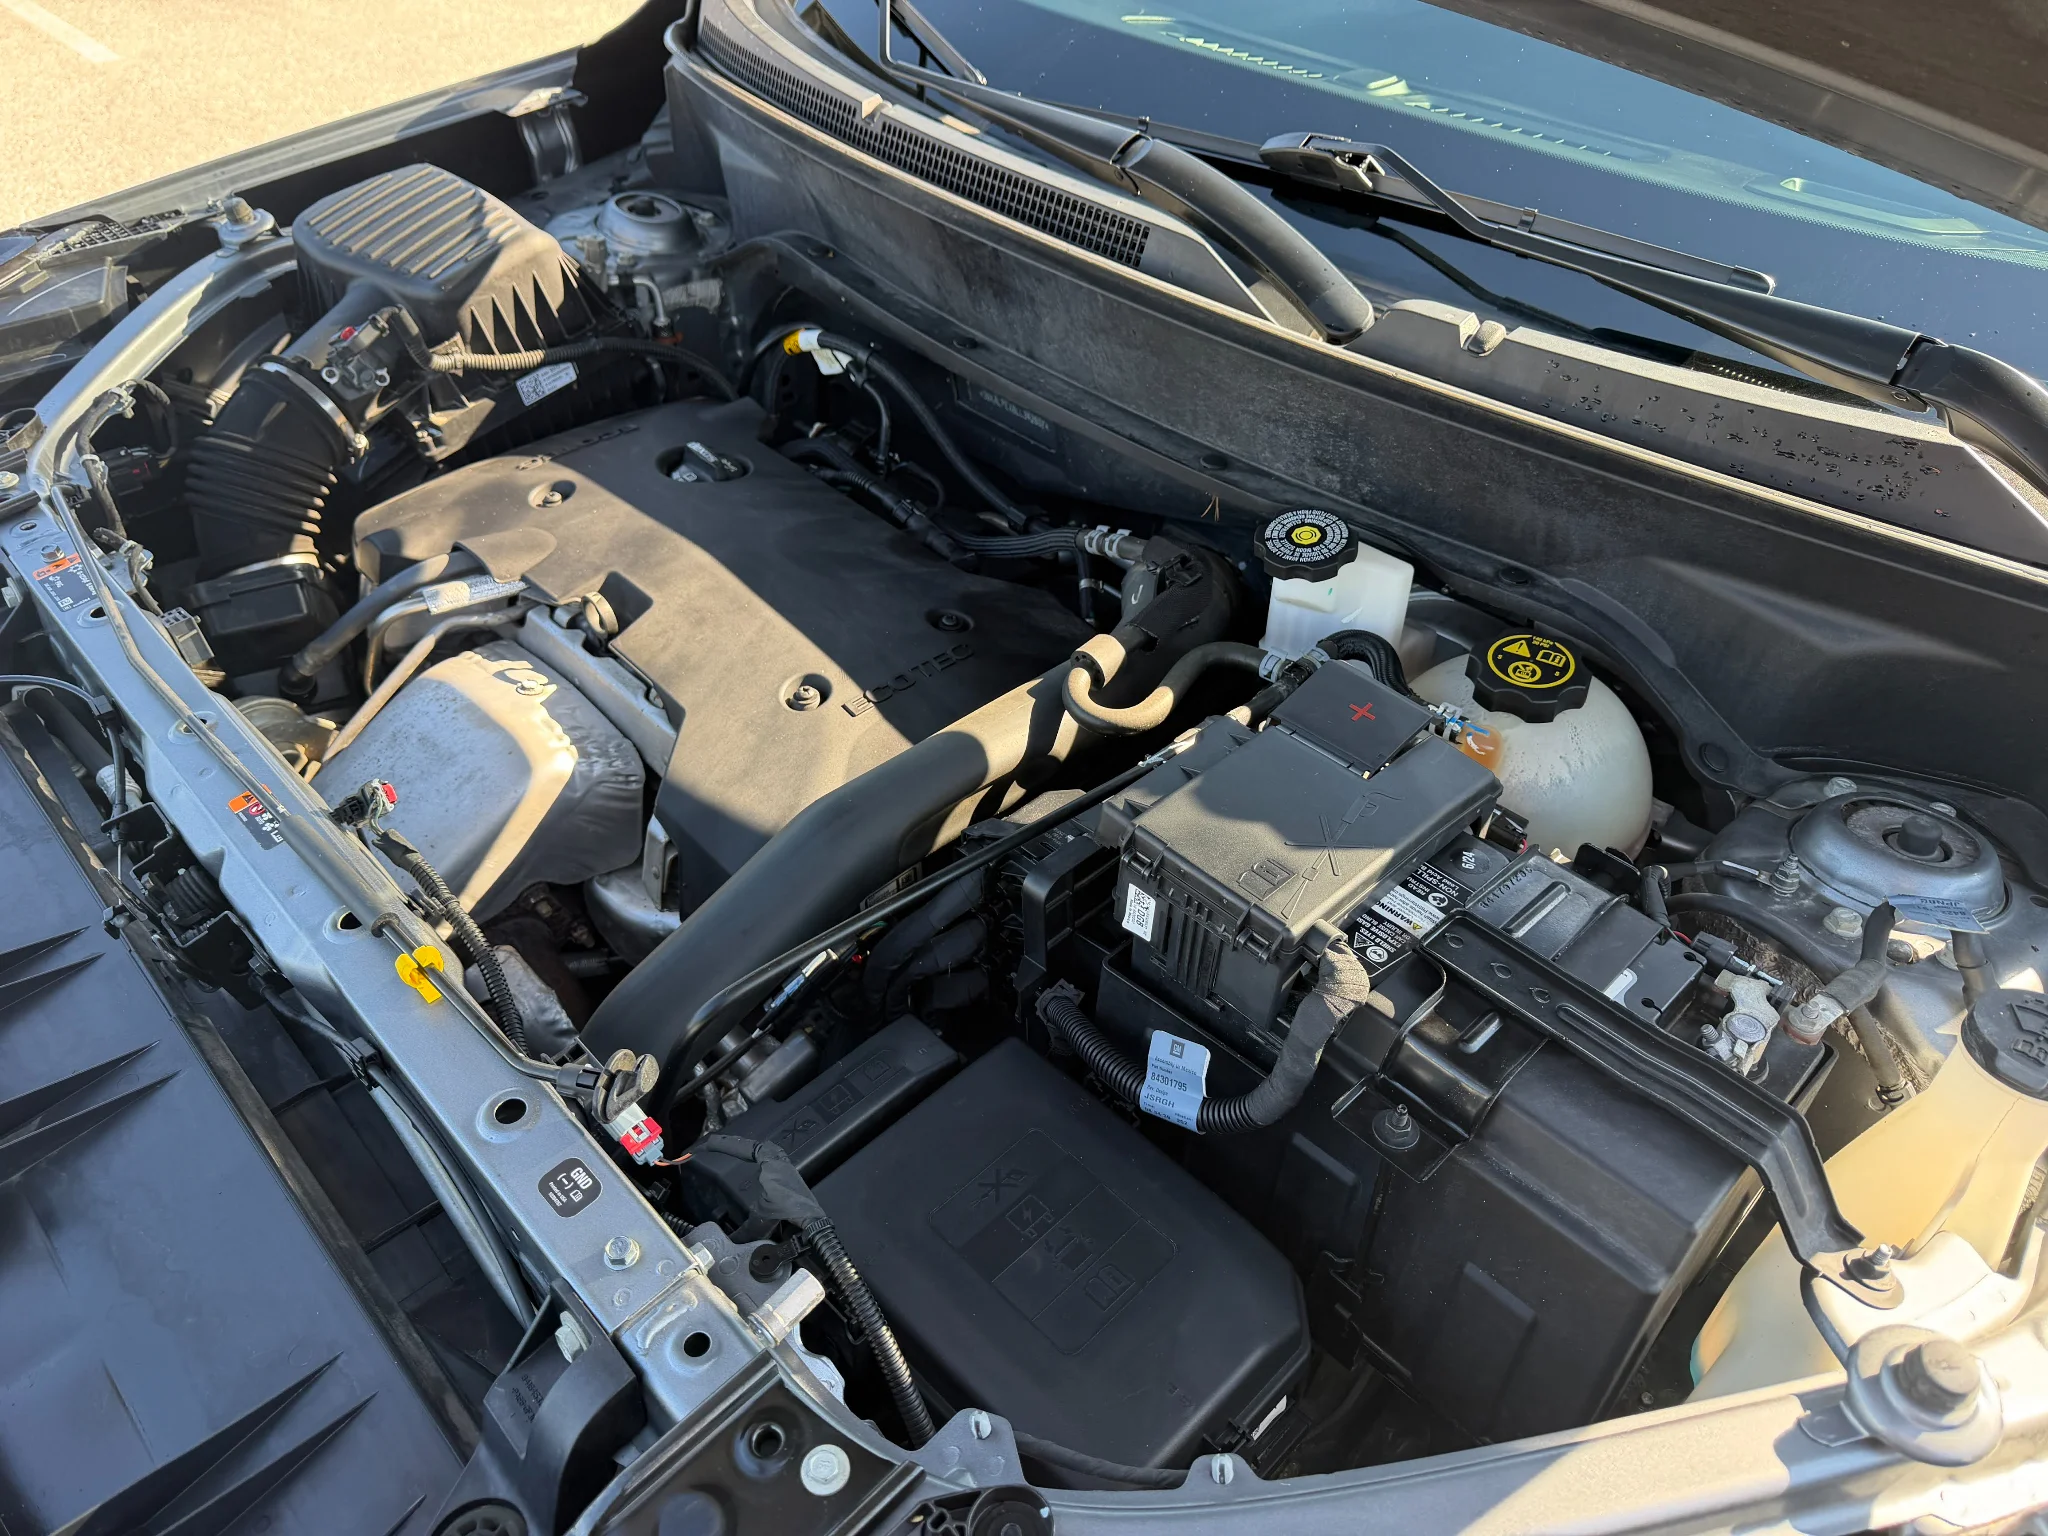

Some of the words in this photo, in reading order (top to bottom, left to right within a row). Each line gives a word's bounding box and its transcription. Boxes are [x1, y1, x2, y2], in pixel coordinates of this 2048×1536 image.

[842, 642, 975, 718] ECOTEC
[1462, 851, 1476, 869] 6/24
[1426, 868, 1442, 880] Acid
[1407, 882, 1426, 896] READ
[1442, 878, 1460, 891] Lead
[1370, 925, 1402, 948] EXPLOSIVE
[1377, 923, 1396, 937] CAUSE
[1402, 932, 1411, 940] OR
[1375, 937, 1397, 953] SHIELD
[1394, 934, 1406, 944] CAN
[1173, 1043, 1182, 1053] GM
[1150, 1072, 1188, 1092] 84301795
[1144, 1092, 1176, 1108] JSRGH
[570, 1166, 593, 1190] GND
